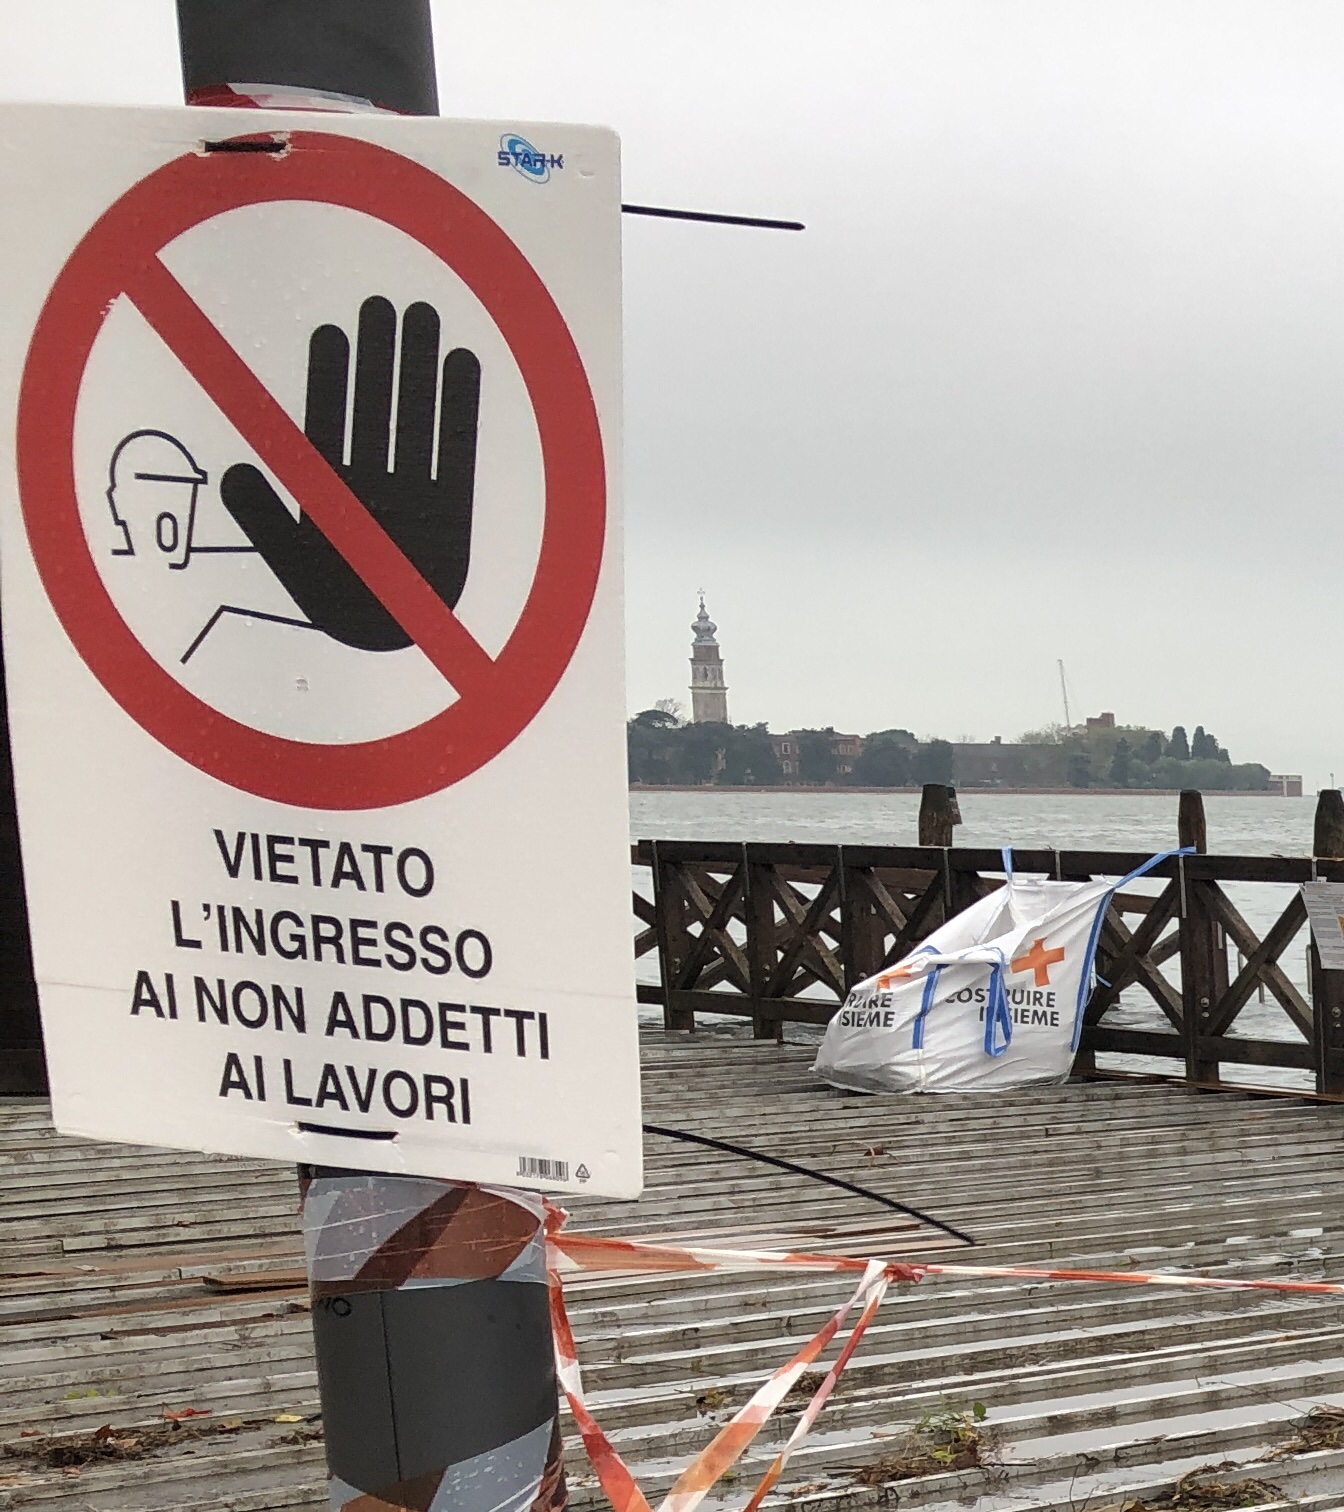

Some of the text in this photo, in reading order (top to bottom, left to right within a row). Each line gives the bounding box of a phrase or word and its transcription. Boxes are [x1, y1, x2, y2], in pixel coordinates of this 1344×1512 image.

[497, 150, 564, 169] STAR-K
[213, 828, 435, 898] VIETATO
[171, 899, 493, 979] L'INGRESSO
[130, 970, 549, 1060] AI NON ADDETTI
[945, 987, 1056, 1008] COSUIRE
[979, 1006, 1060, 1028] IIEME
[219, 1052, 471, 1125] AI LAVORI
